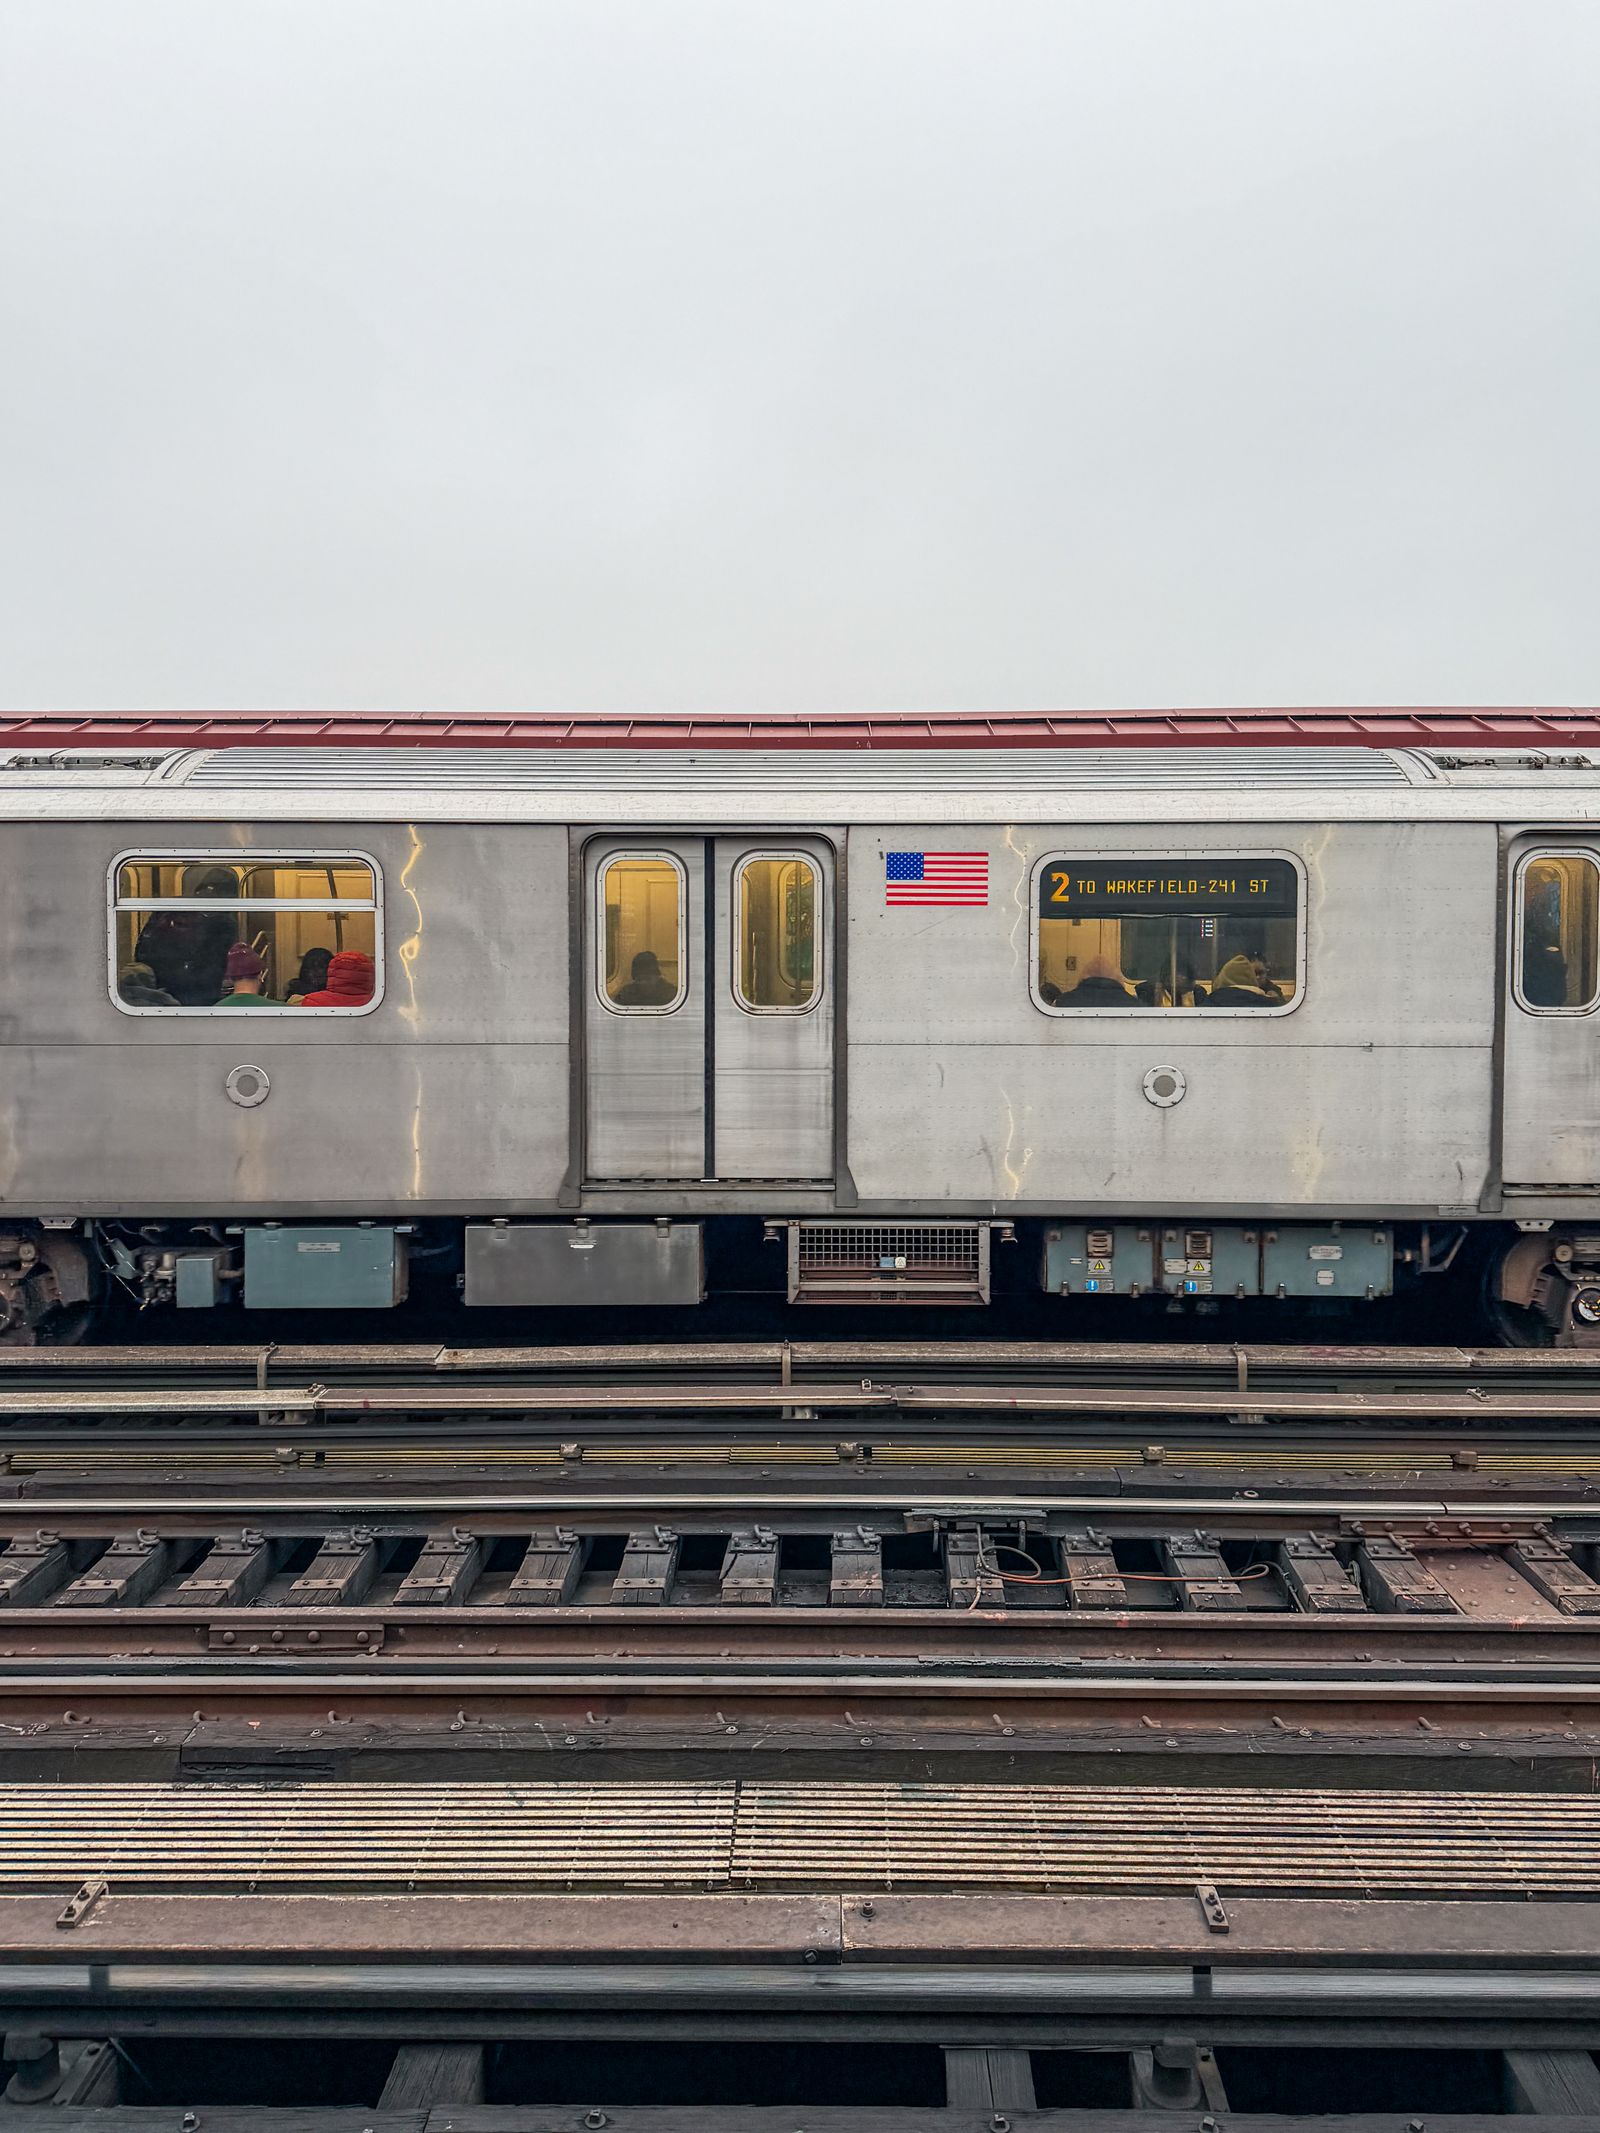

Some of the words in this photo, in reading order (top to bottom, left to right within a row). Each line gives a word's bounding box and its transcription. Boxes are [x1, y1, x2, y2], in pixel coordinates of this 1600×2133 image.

[1051, 872, 1070, 902] 2
[1077, 880, 1096, 894] TO
[1107, 880, 1236, 894] WAKEFIELD-241
[1249, 880, 1269, 893] ST
